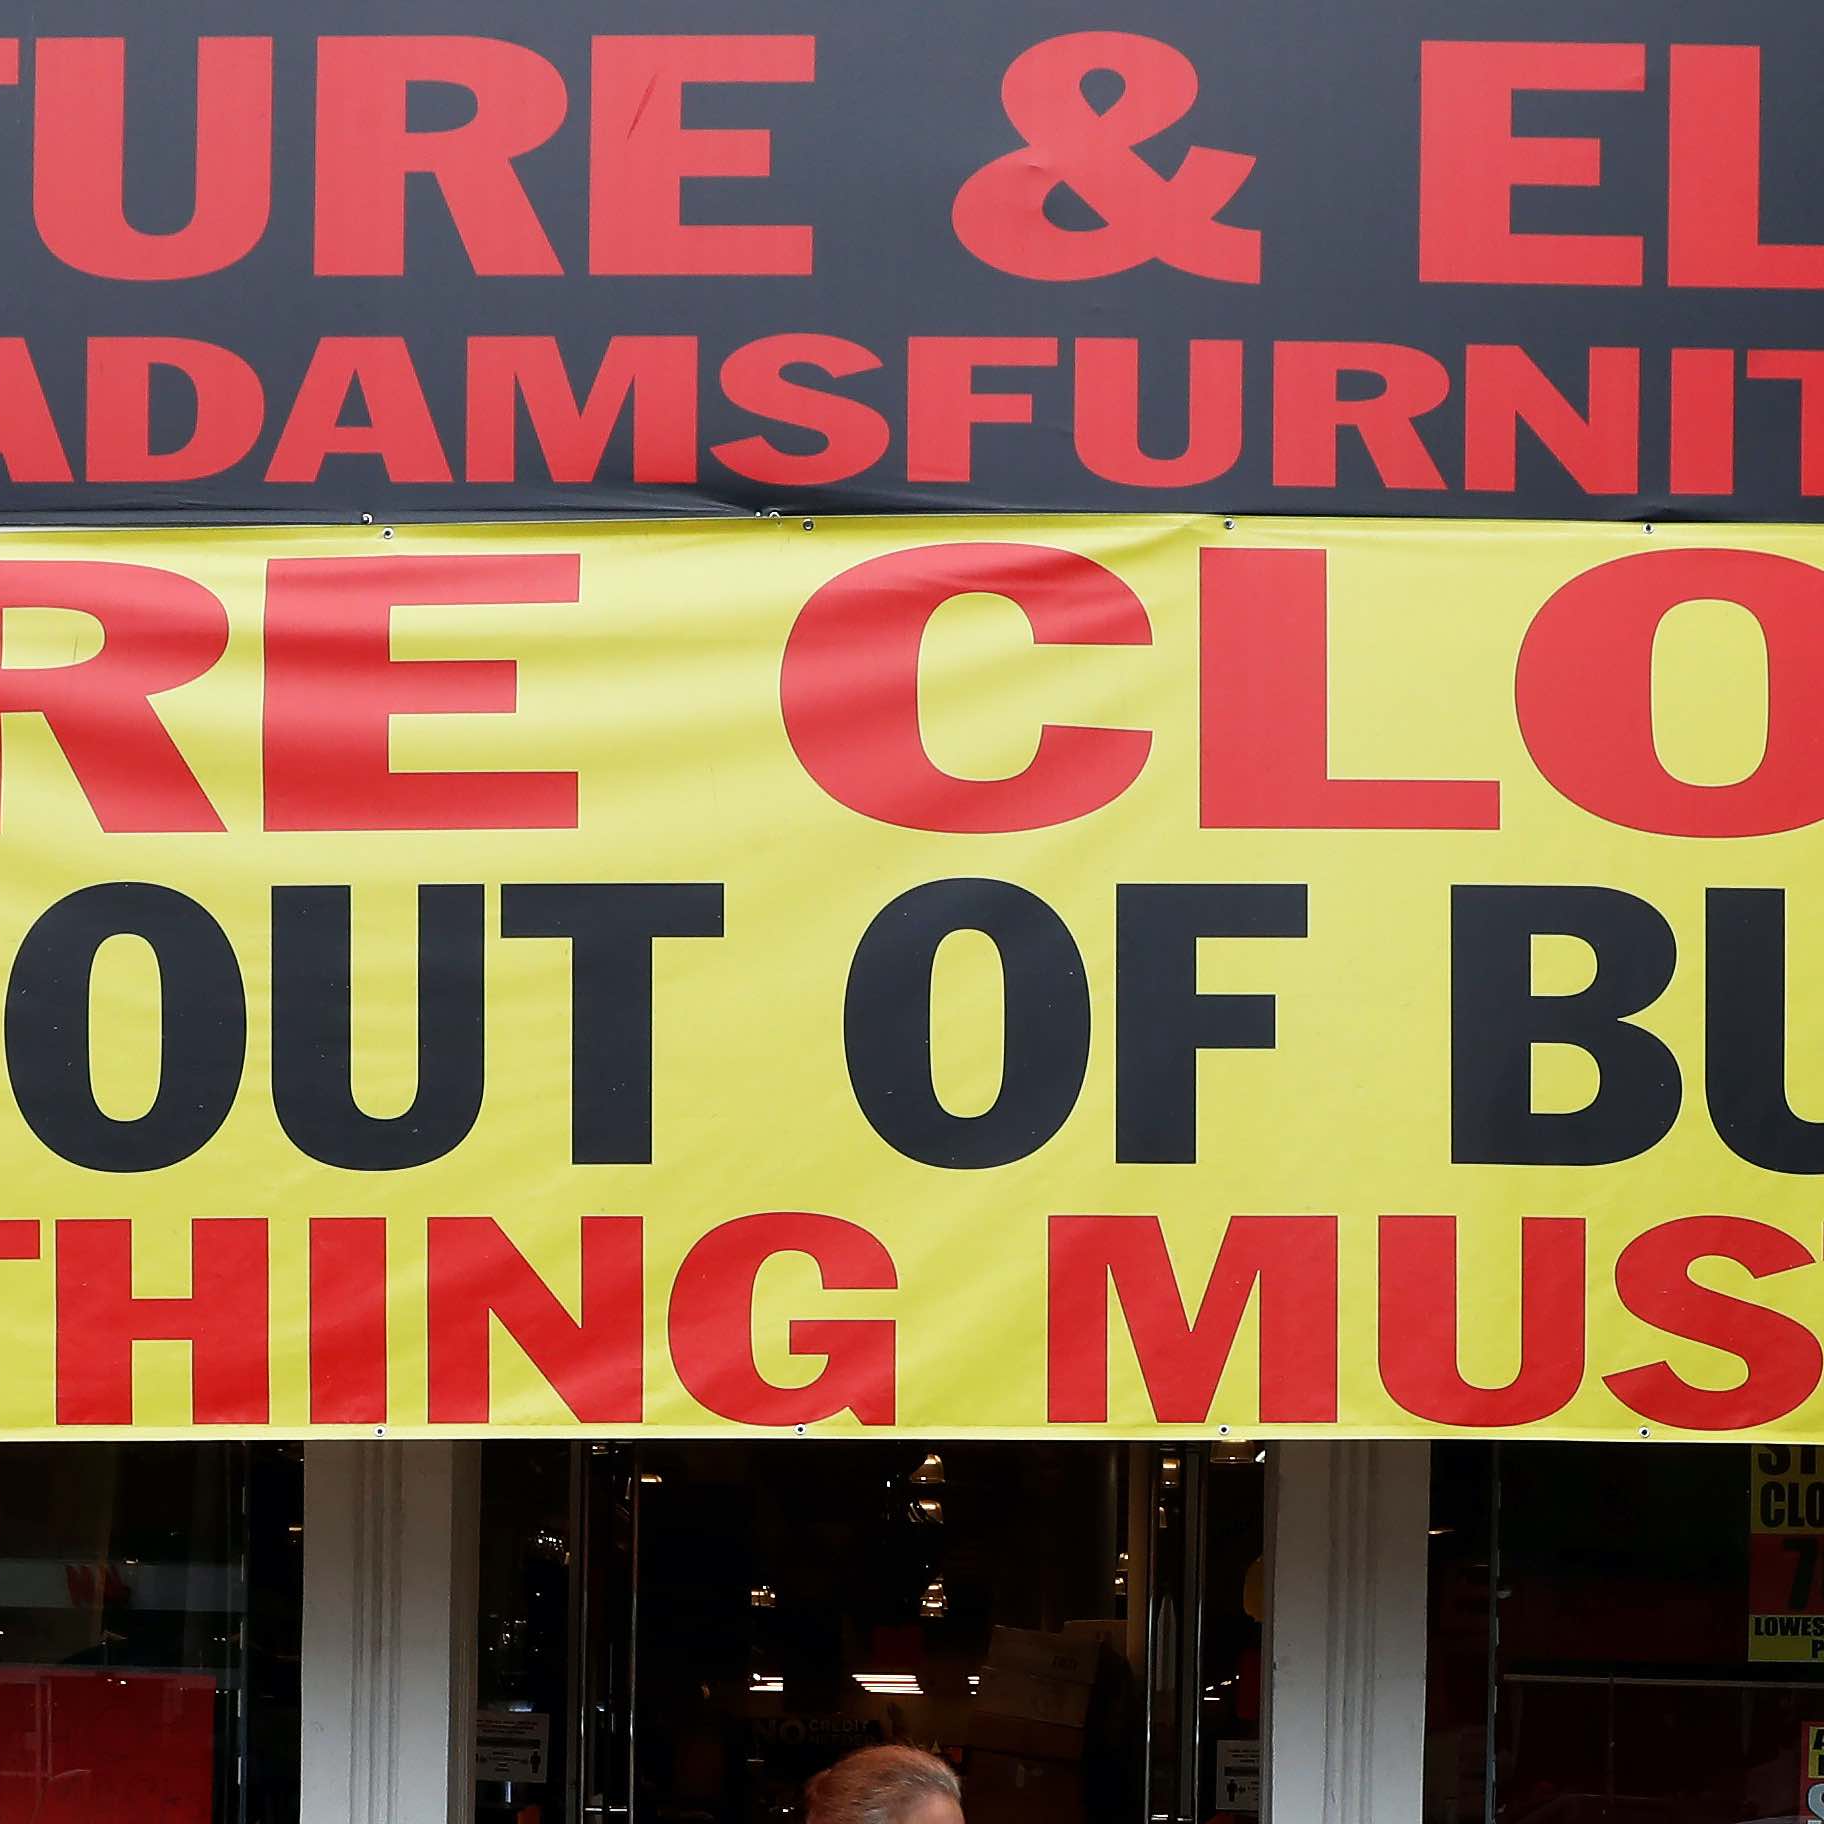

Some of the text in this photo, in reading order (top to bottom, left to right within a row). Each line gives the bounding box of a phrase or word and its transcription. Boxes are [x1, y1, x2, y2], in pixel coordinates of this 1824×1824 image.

[950, 31, 1262, 287] &
[3, 879, 726, 1175] OUT
[842, 876, 1310, 1171] OF
